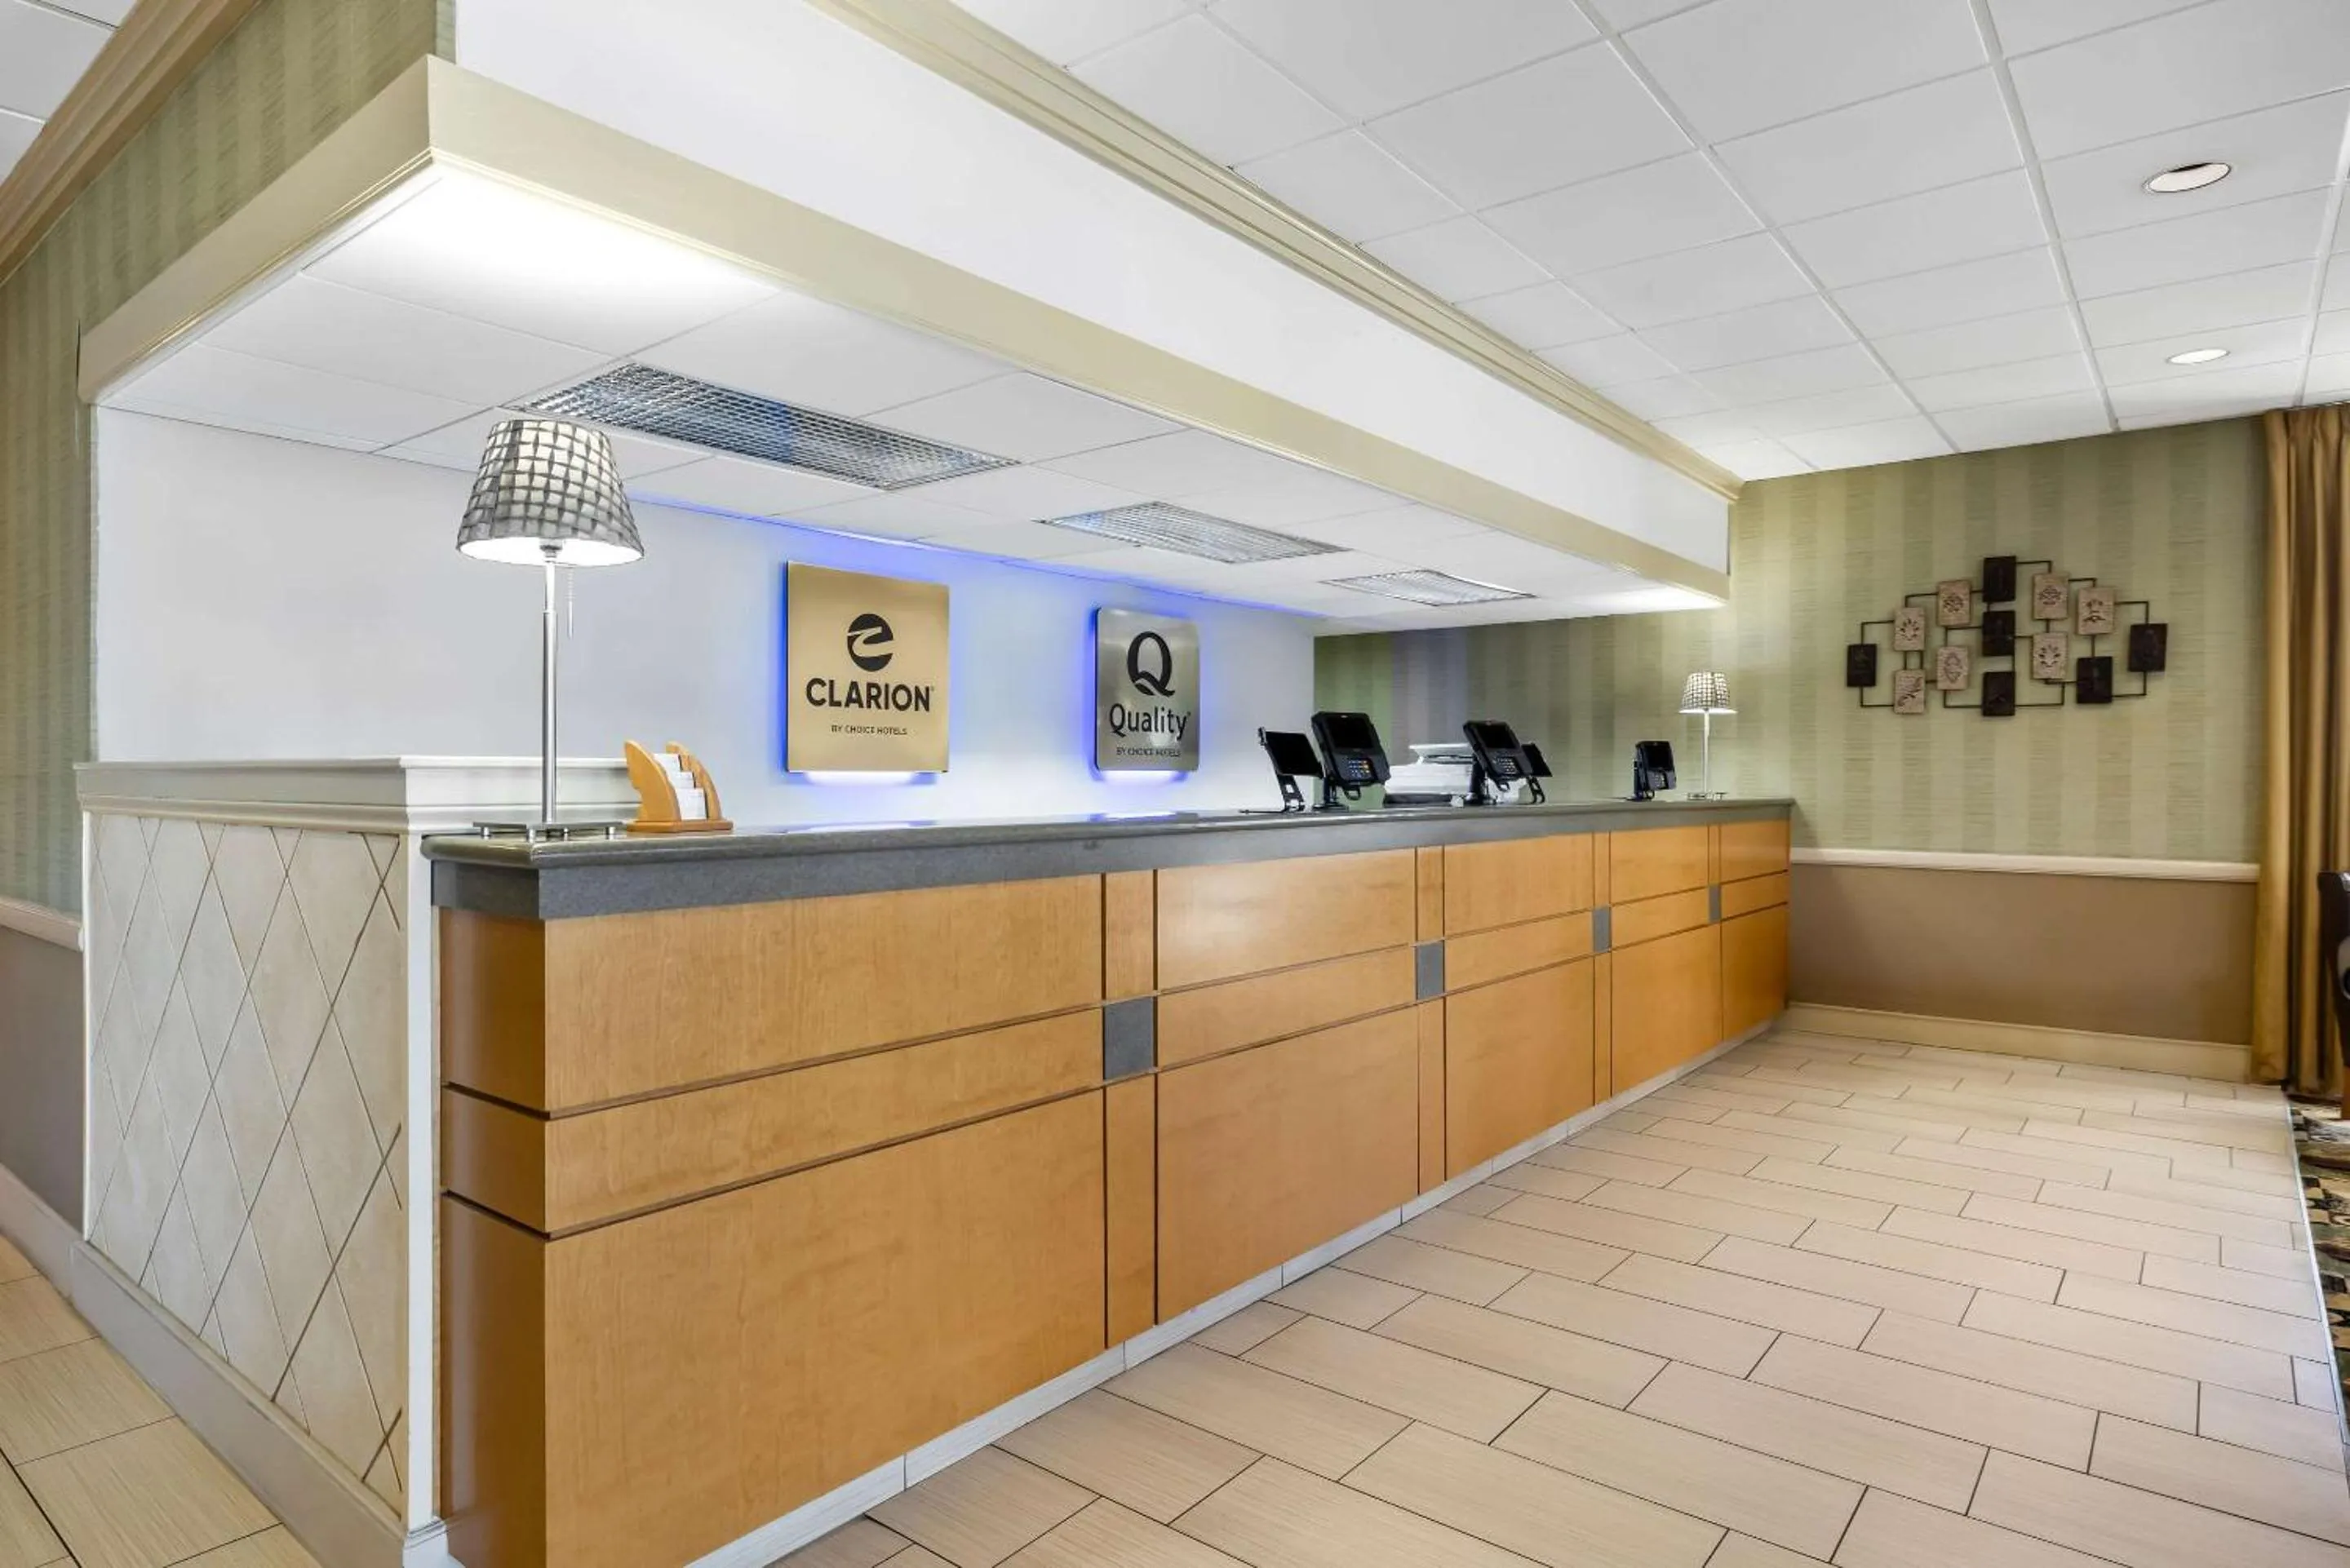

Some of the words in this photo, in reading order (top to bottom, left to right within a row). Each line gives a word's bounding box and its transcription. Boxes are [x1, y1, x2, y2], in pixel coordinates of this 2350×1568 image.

[806, 678, 930, 712] CLARION
[845, 724, 875, 734] CHOICE
[877, 726, 907, 735] HOTELS
[1109, 703, 1186, 741] Quality
